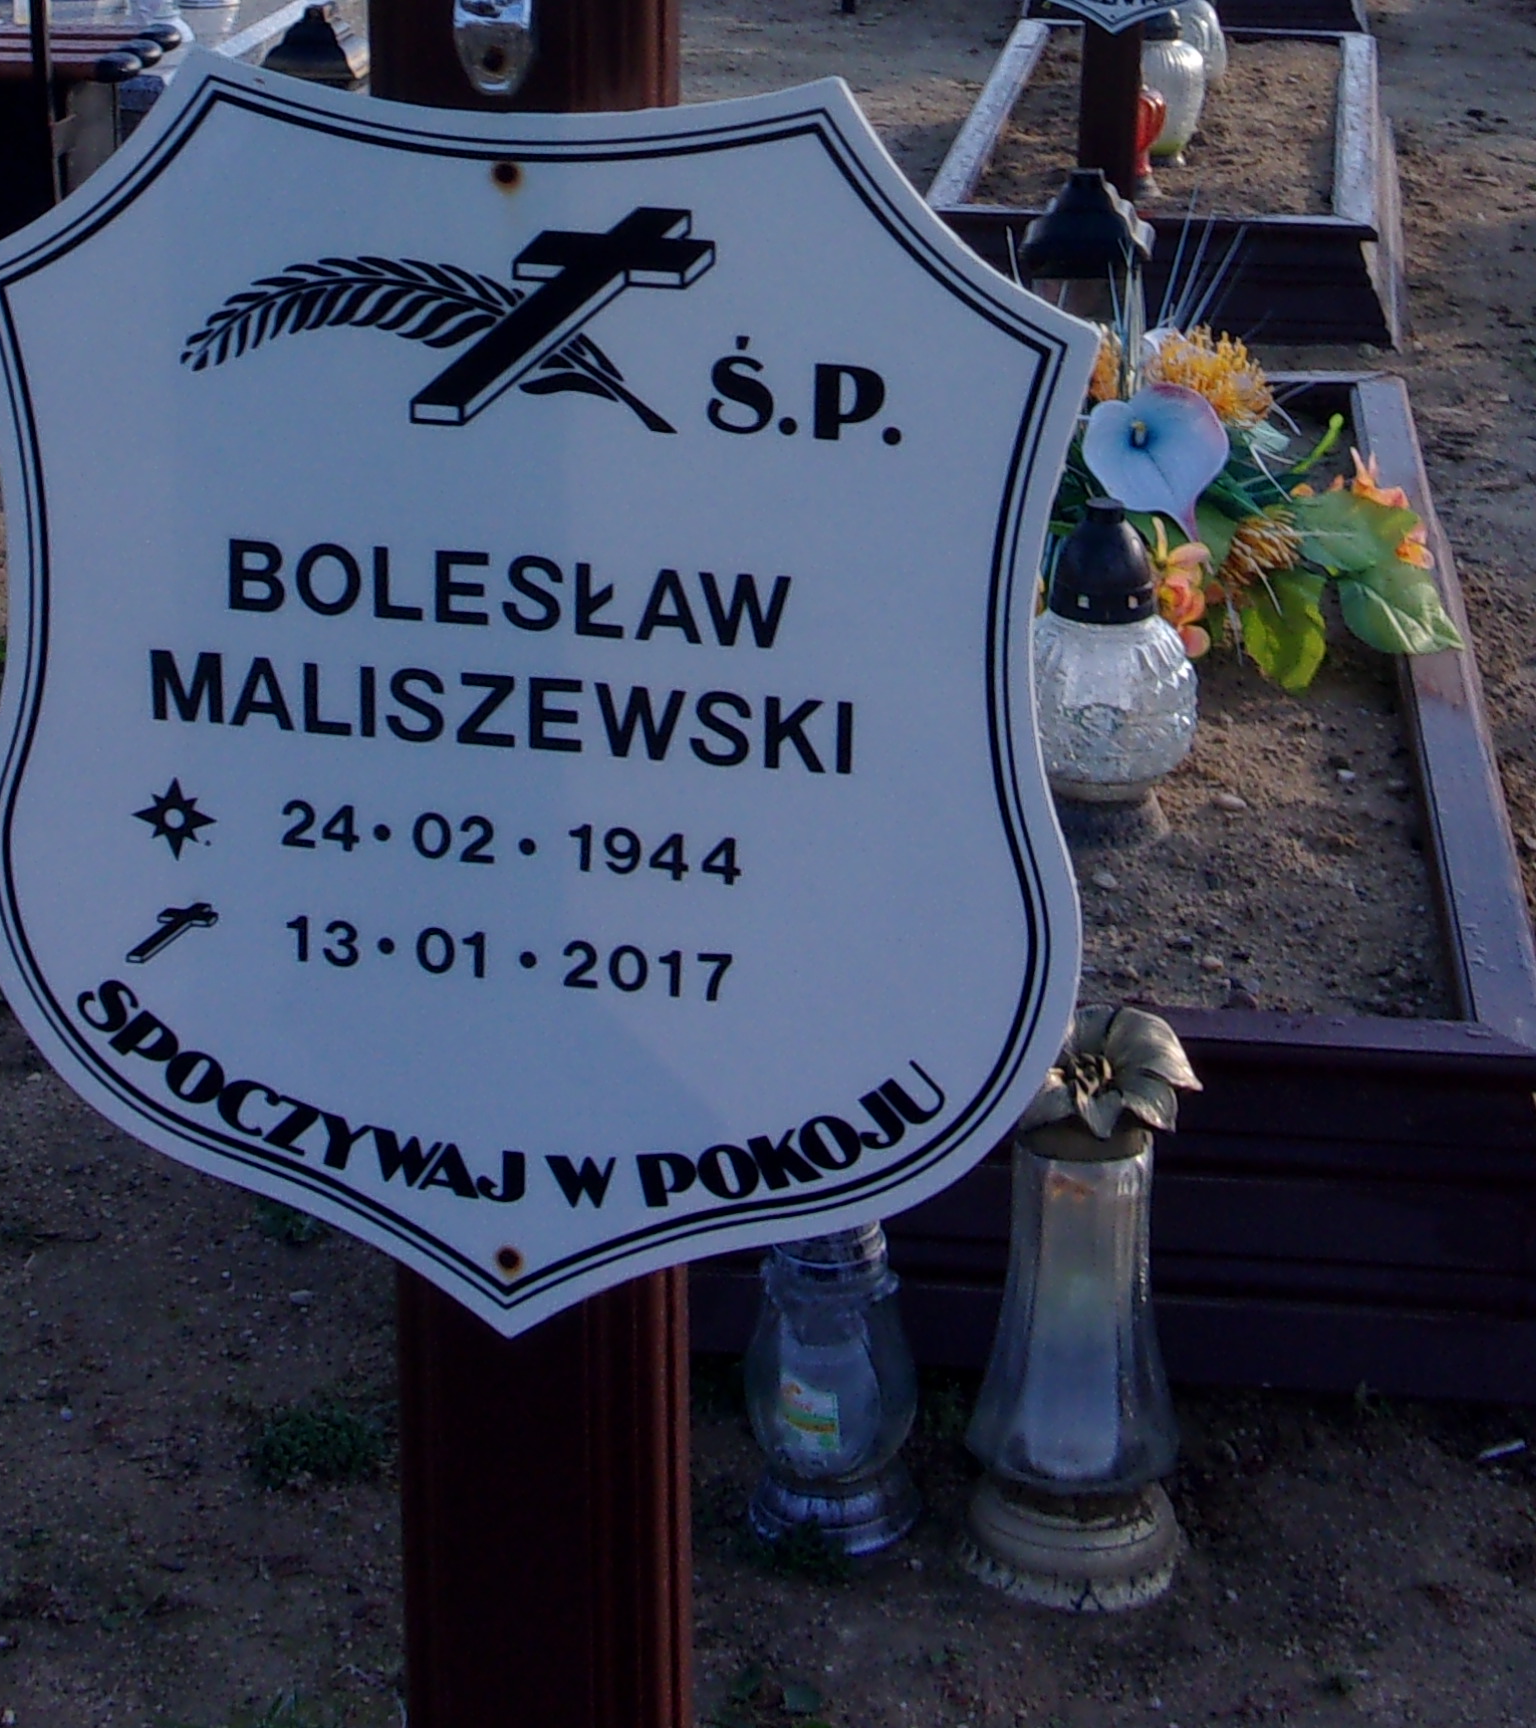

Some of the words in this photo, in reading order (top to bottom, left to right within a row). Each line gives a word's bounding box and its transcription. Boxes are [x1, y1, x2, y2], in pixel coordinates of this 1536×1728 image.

[227, 537, 792, 649] BOLESŁAW
[149, 648, 854, 775] MALISZEWSKI
[76, 979, 526, 1204] SPOCZYWAJ
[543, 1154, 617, 1209] W
[635, 1059, 946, 1208] POKOJU
